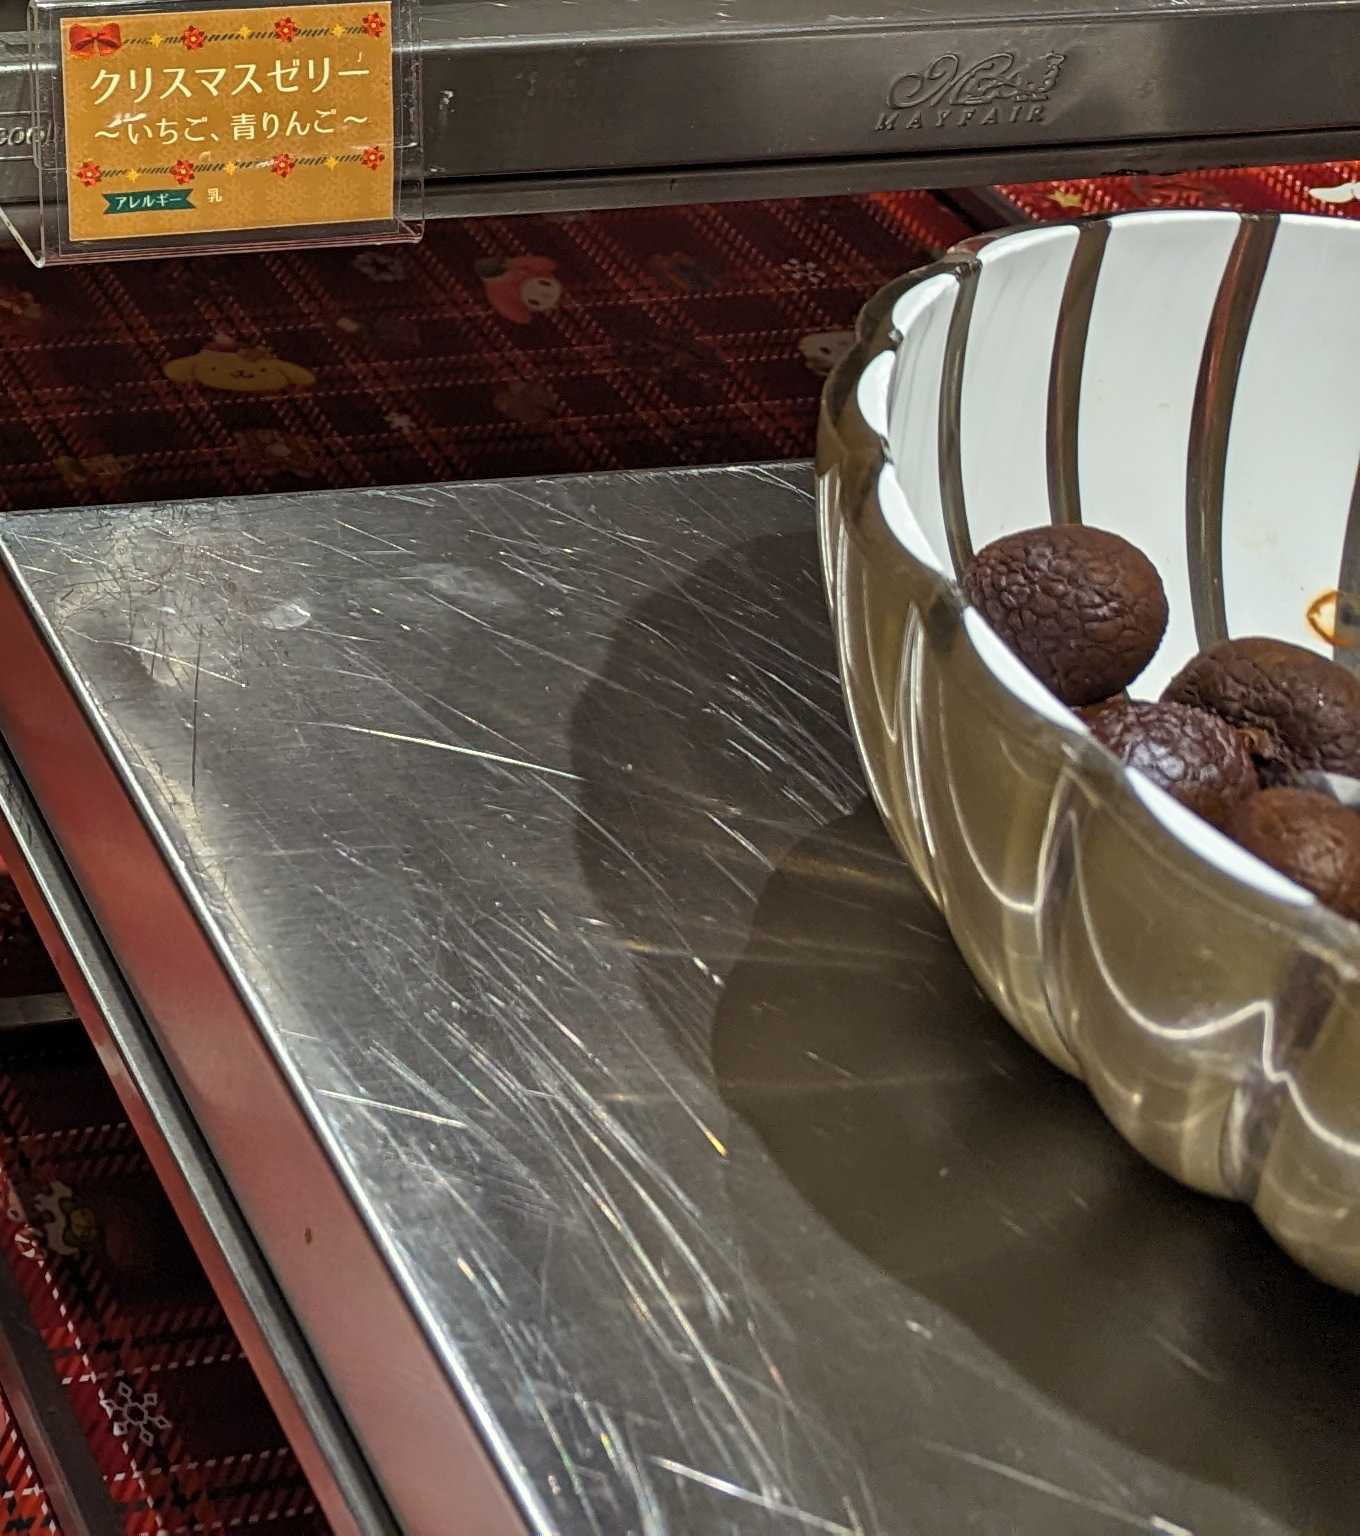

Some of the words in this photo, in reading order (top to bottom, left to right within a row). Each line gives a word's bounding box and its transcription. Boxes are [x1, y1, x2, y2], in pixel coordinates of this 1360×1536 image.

[90, 57, 370, 104] クリスマスゼリー
[874, 106, 1047, 131] MAYFAIR
[116, 192, 182, 211] アレルギー
[207, 187, 223, 204] 乳
